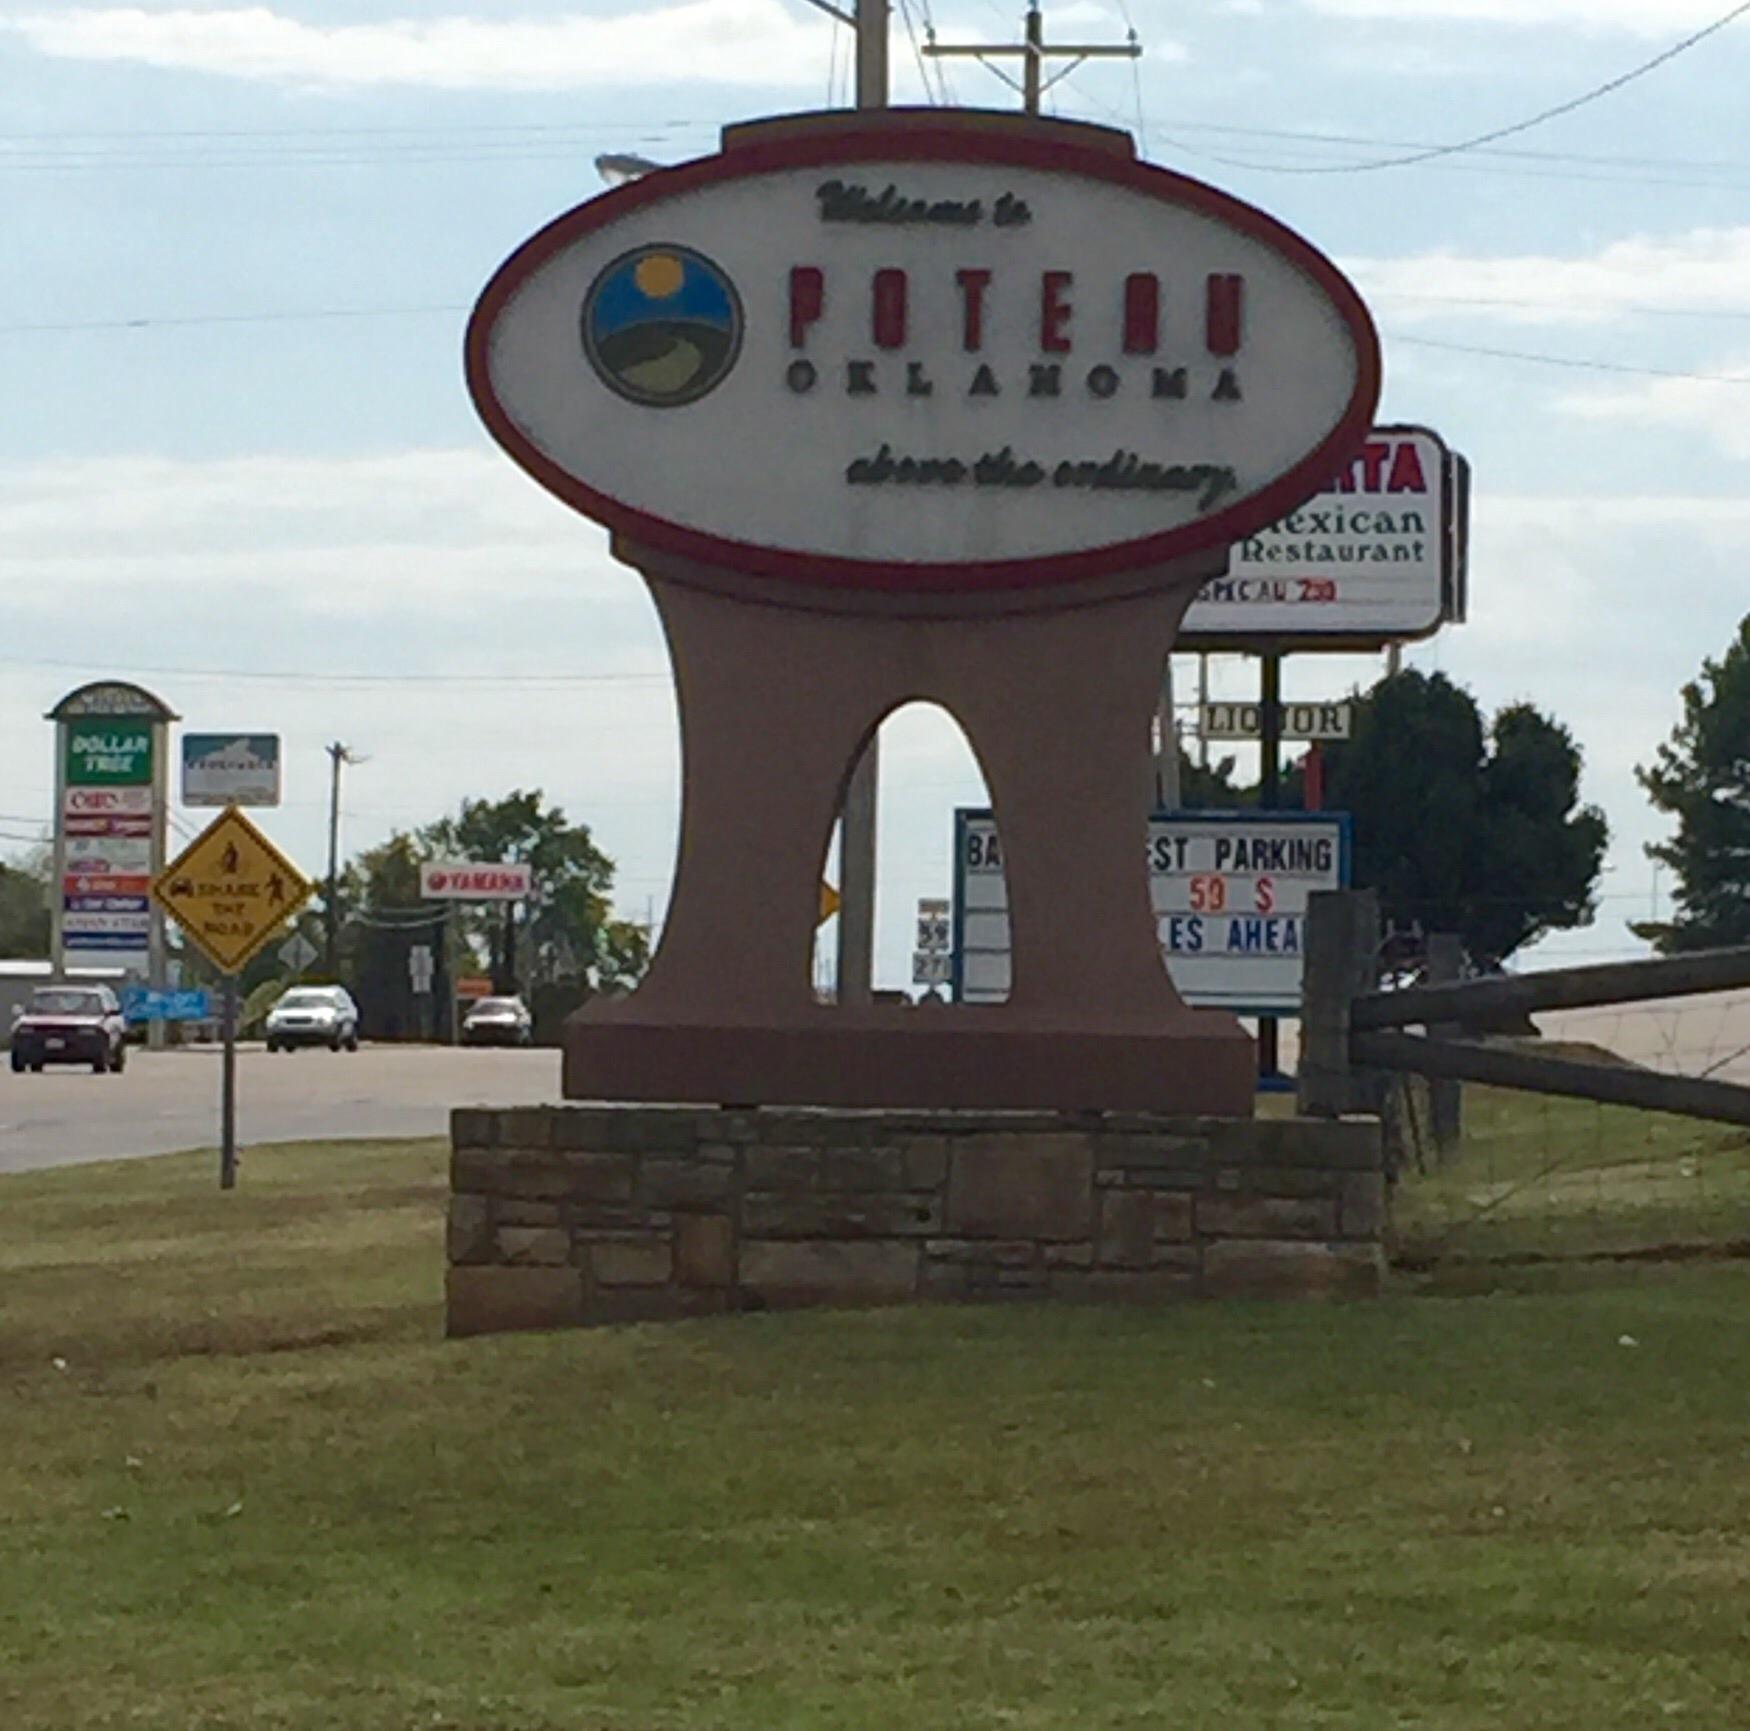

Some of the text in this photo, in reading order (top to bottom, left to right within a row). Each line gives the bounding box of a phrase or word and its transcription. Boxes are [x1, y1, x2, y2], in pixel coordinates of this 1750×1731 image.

[816, 179, 1031, 227] Welcome to
[789, 265, 1244, 357] POTEAU
[787, 358, 1242, 400] OKLAHOMA
[846, 443, 1236, 511] above the ordinary
[1256, 504, 1425, 534] exican
[1240, 538, 1424, 562] Restaurant
[72, 735, 148, 753] DOLLAR
[1149, 836, 1188, 871] ST
[1215, 838, 1332, 872] PARKING
[449, 871, 524, 890] YAMAHA
[1255, 876, 1273, 912] S
[204, 920, 255, 935] ROAD
[1169, 916, 1299, 952] ES AHEA
